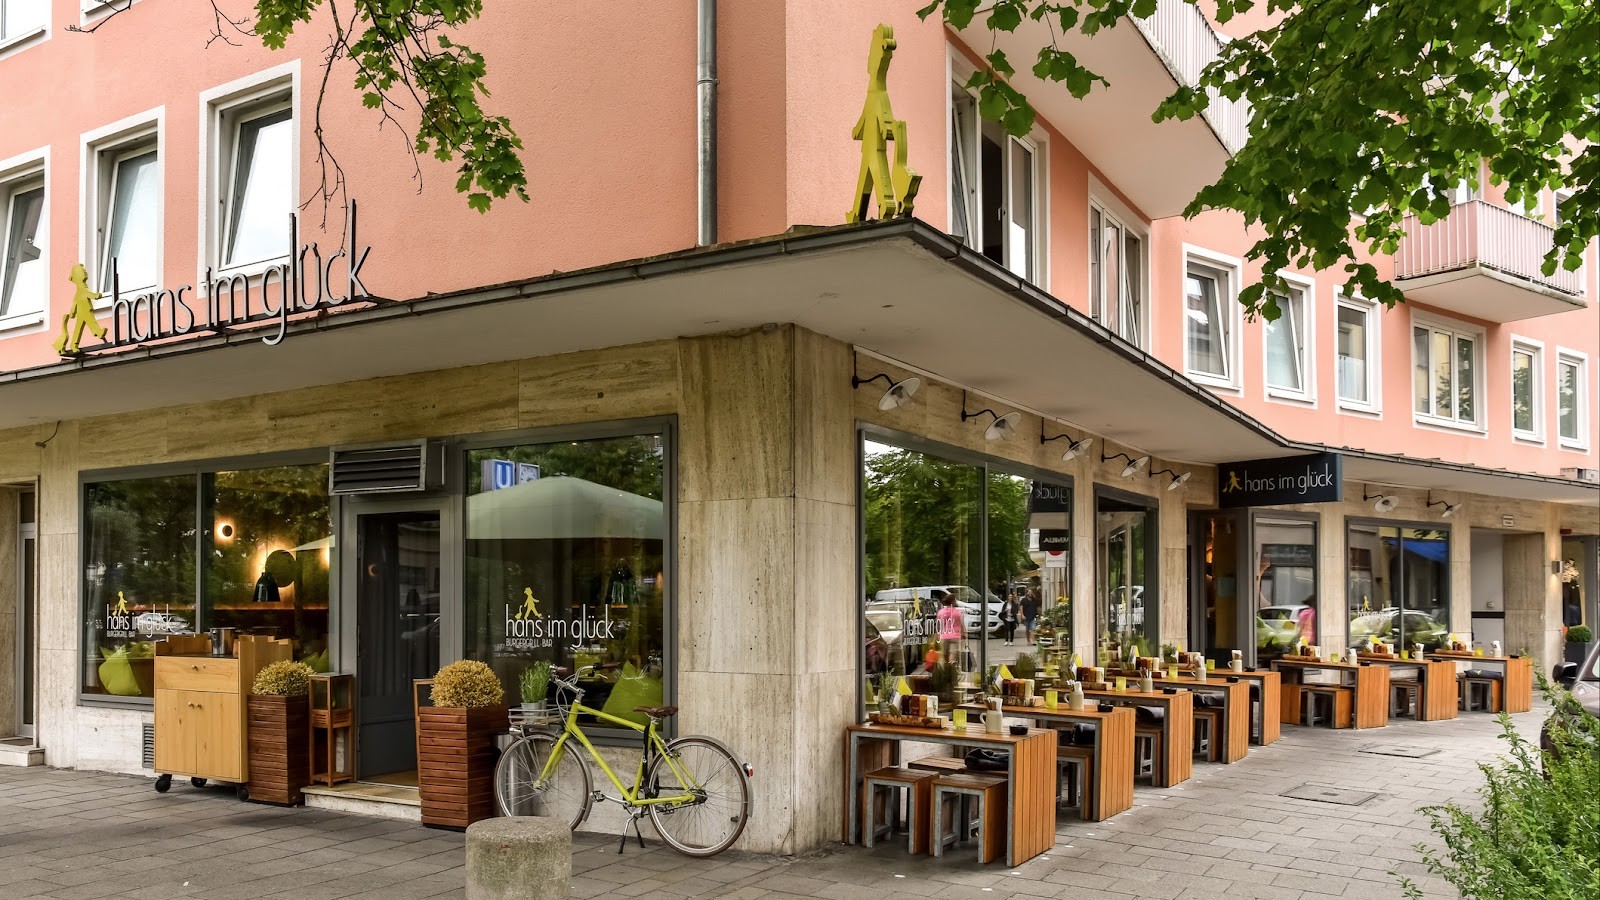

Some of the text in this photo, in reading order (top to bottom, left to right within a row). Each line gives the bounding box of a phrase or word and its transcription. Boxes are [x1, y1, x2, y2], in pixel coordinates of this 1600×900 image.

[112, 199, 371, 345] hans im glück
[496, 464, 511, 488] U
[1244, 463, 1333, 494] hans im glück
[107, 604, 130, 630] hans
[505, 604, 614, 648] hans im glück
